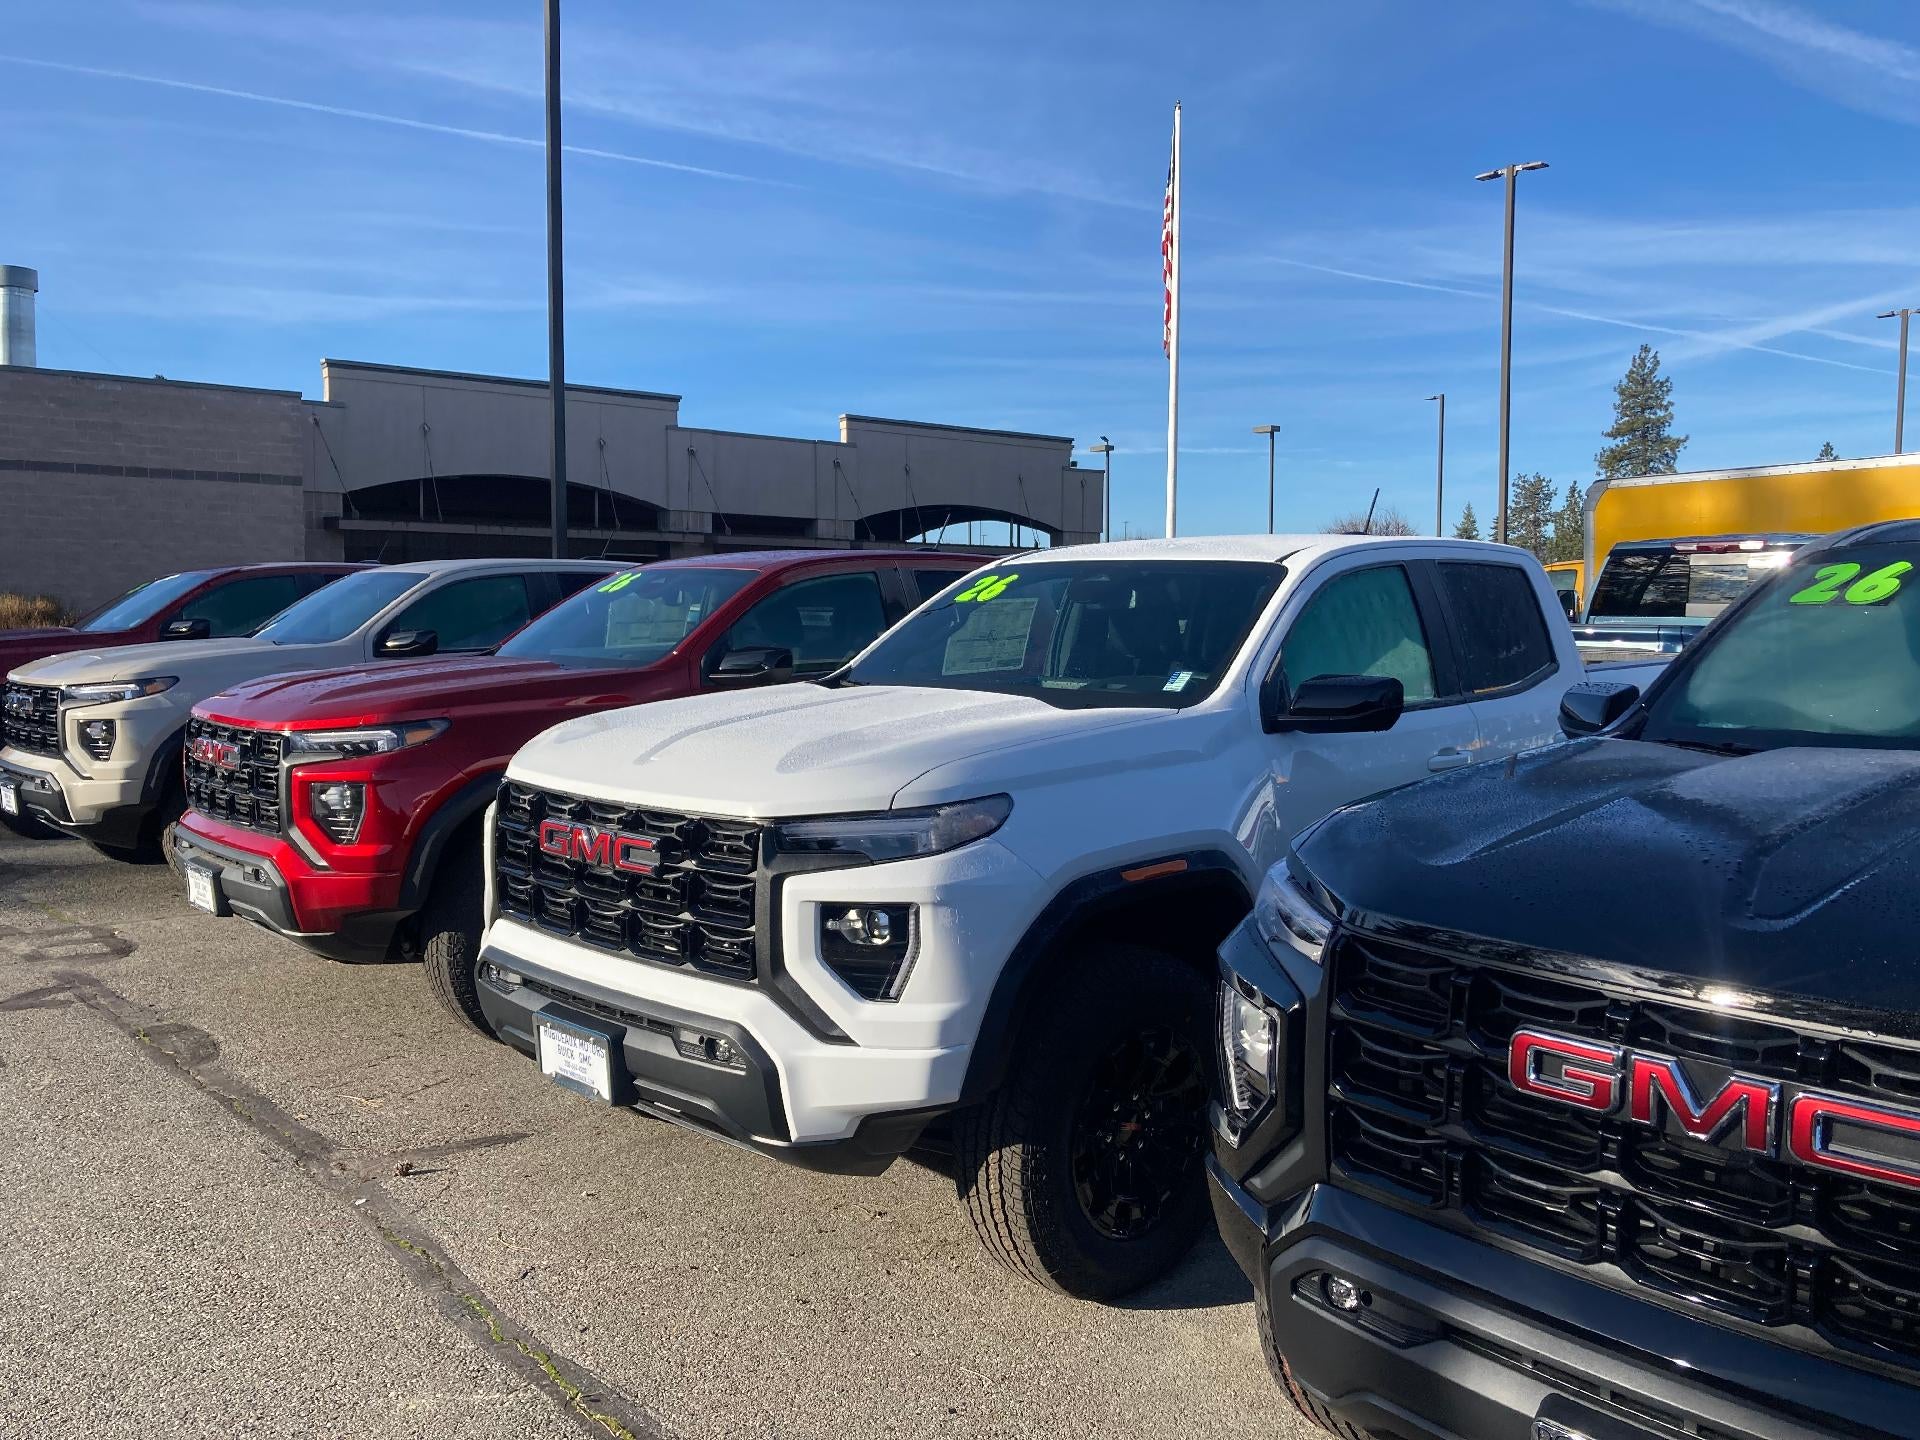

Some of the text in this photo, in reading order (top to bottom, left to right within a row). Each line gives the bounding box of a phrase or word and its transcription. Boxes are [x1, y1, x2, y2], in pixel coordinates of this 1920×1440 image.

[954, 574, 1019, 603] 26
[1790, 561, 1914, 605] 26
[538, 818, 660, 875] GMC
[1508, 1024, 1920, 1189] GMC
